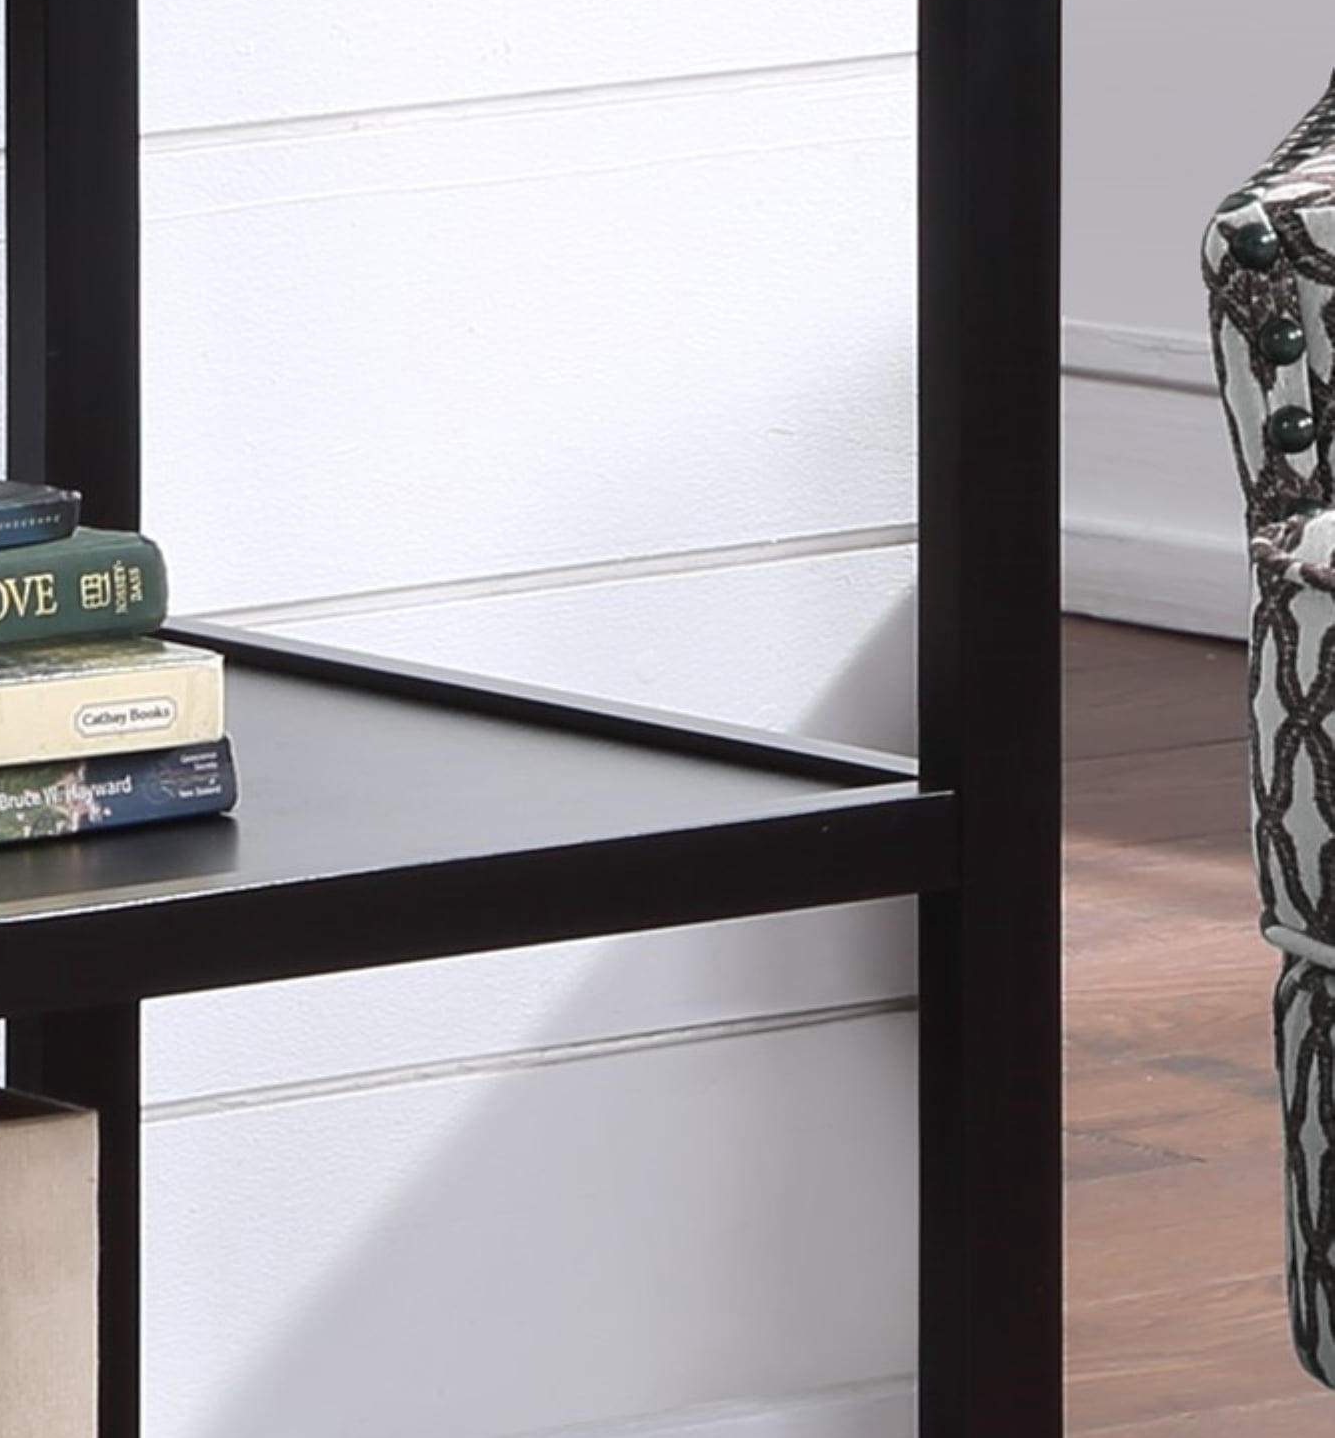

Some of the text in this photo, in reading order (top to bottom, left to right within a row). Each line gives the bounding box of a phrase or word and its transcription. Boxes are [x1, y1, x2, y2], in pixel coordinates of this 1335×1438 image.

[81, 705, 170, 727] Cathay Books
[65, 775, 133, 802] Hayward
